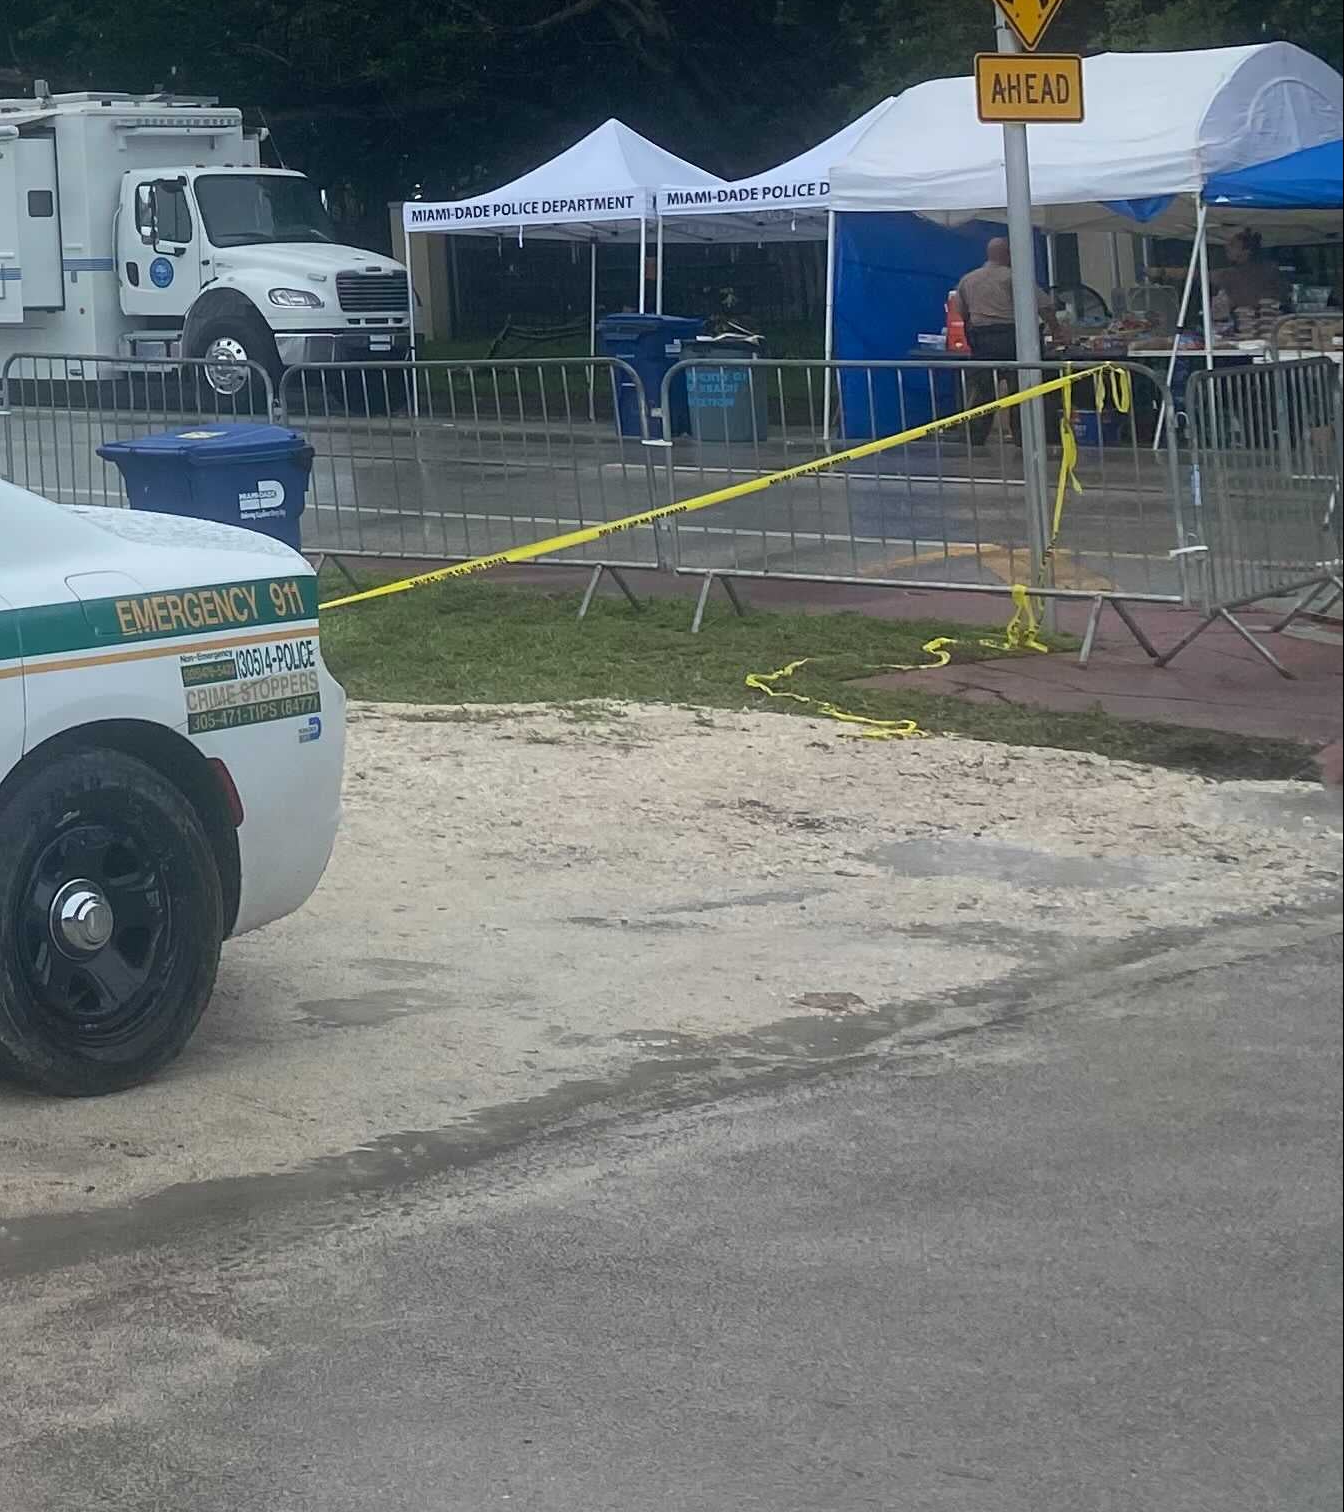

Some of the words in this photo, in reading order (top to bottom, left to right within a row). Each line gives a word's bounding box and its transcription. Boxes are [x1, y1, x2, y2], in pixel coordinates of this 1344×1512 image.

[992, 73, 1070, 104] AHEAD
[412, 204, 490, 222] MIAMI-DADE
[493, 200, 538, 217] POLICE
[541, 195, 634, 213] DEPARTMENT
[667, 186, 759, 206] MIAMI-DADE
[762, 182, 816, 200] POLICE
[115, 586, 259, 635] EMERGENCY
[269, 581, 305, 617] 911
[179, 649, 233, 663] Non-Emergency
[186, 685, 238, 711] CRIME
[239, 671, 319, 702] STOPPERS
